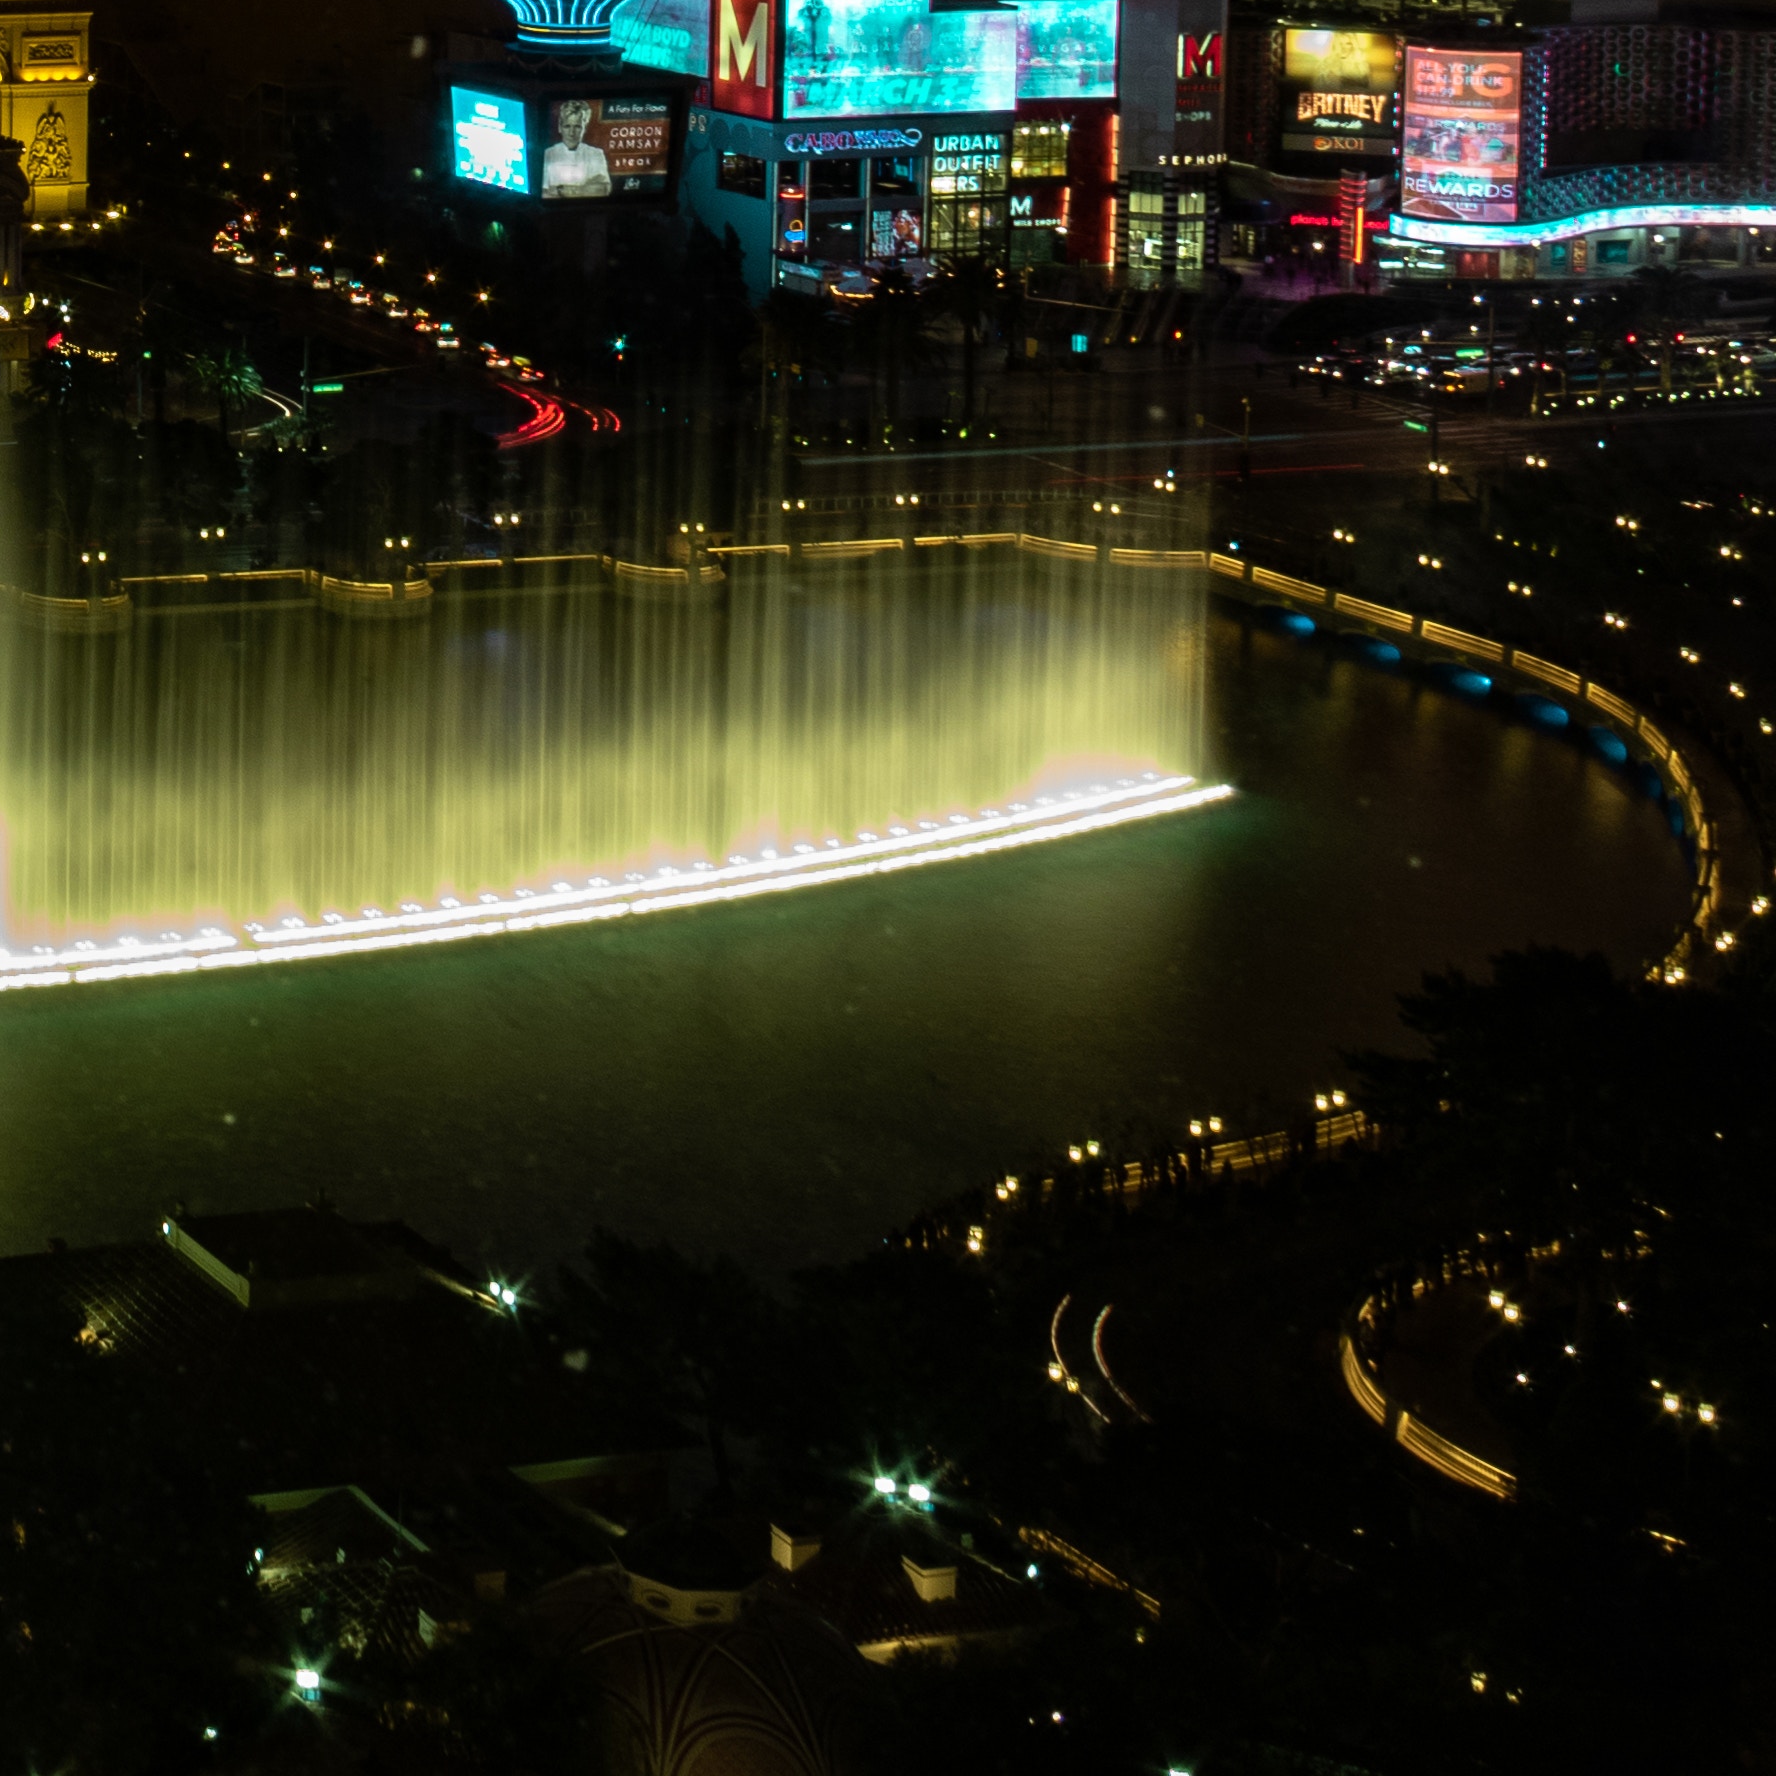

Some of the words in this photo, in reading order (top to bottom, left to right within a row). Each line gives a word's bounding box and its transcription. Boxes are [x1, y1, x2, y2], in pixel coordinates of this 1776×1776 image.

[808, 77, 932, 107] MARCH
[1298, 92, 1386, 123] BRITNEY
[610, 127, 663, 138] GORDON
[609, 139, 662, 150] RAMSAY
[784, 131, 854, 154] CABO
[934, 135, 999, 152] URBAN
[615, 157, 651, 167] steak
[934, 155, 1001, 172] OUTFIT
[1405, 176, 1514, 199] REWARDS
[1010, 196, 1031, 216] M
